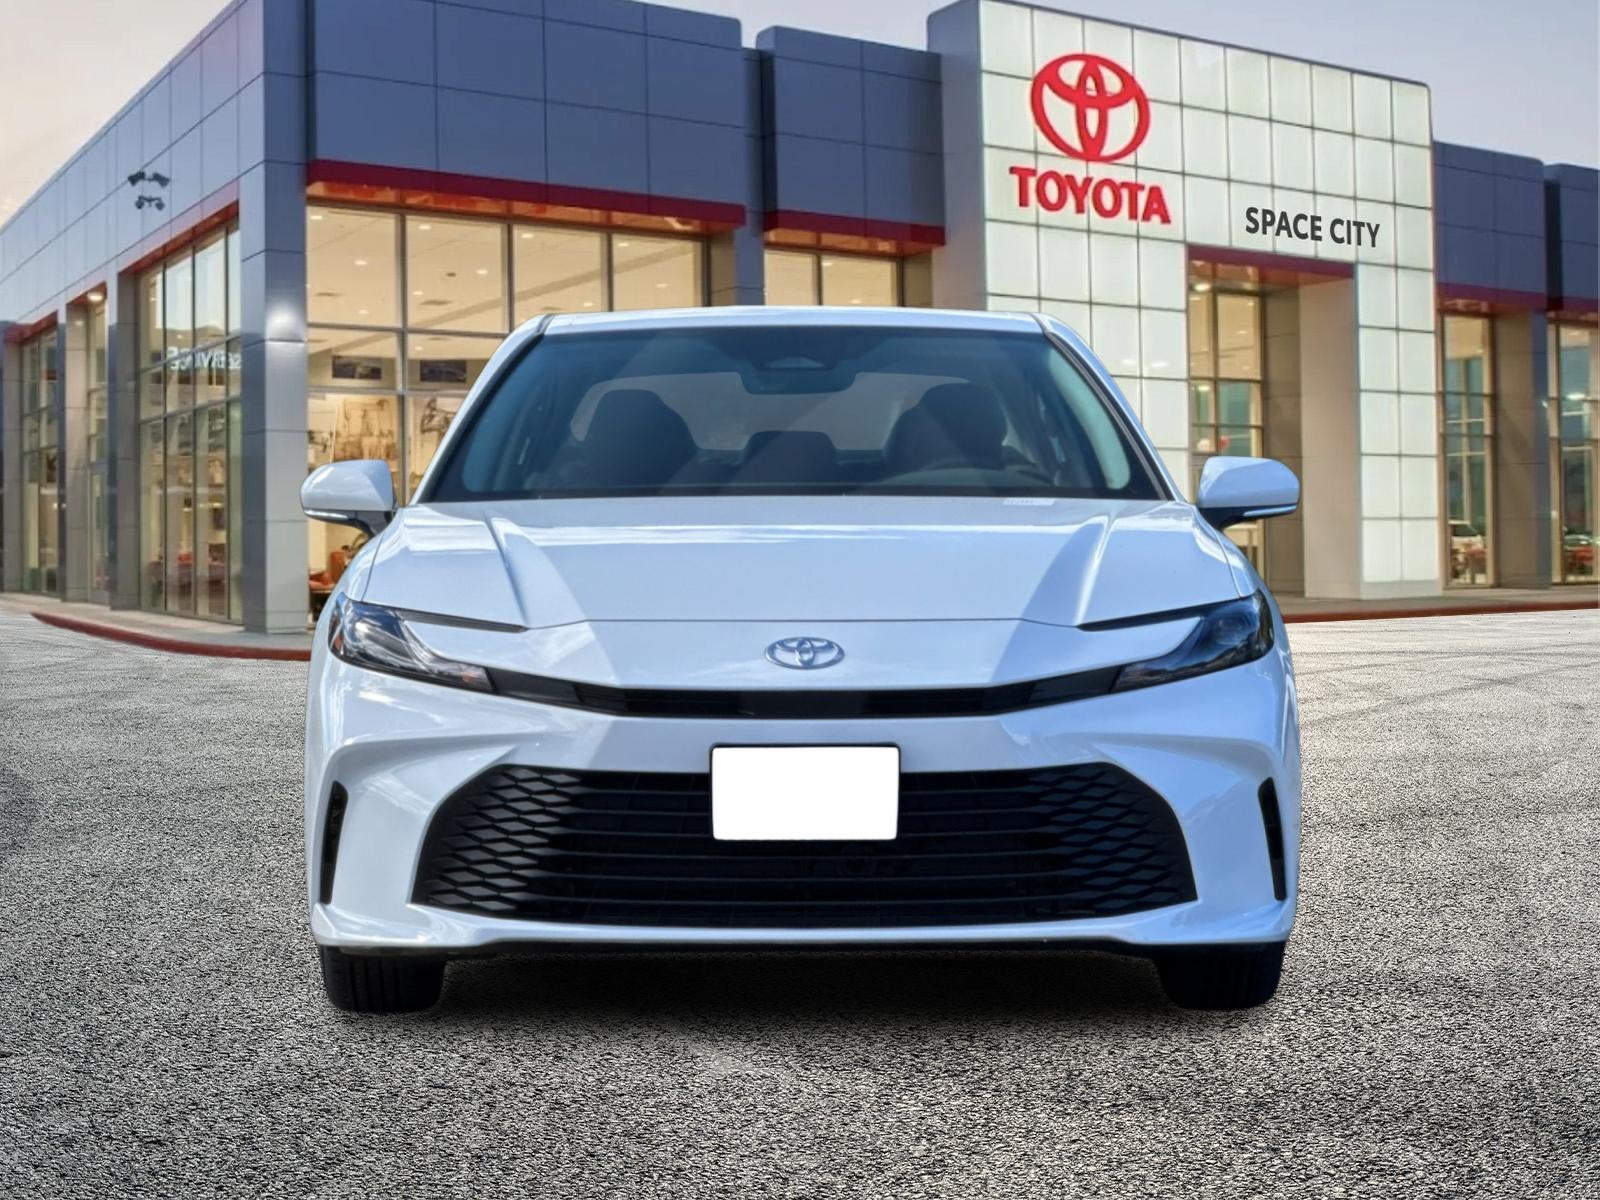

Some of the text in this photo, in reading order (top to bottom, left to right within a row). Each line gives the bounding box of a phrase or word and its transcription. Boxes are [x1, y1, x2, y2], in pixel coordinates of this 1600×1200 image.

[1009, 166, 1171, 225] TOYOTA
[1245, 207, 1381, 248] SPACE CITY
